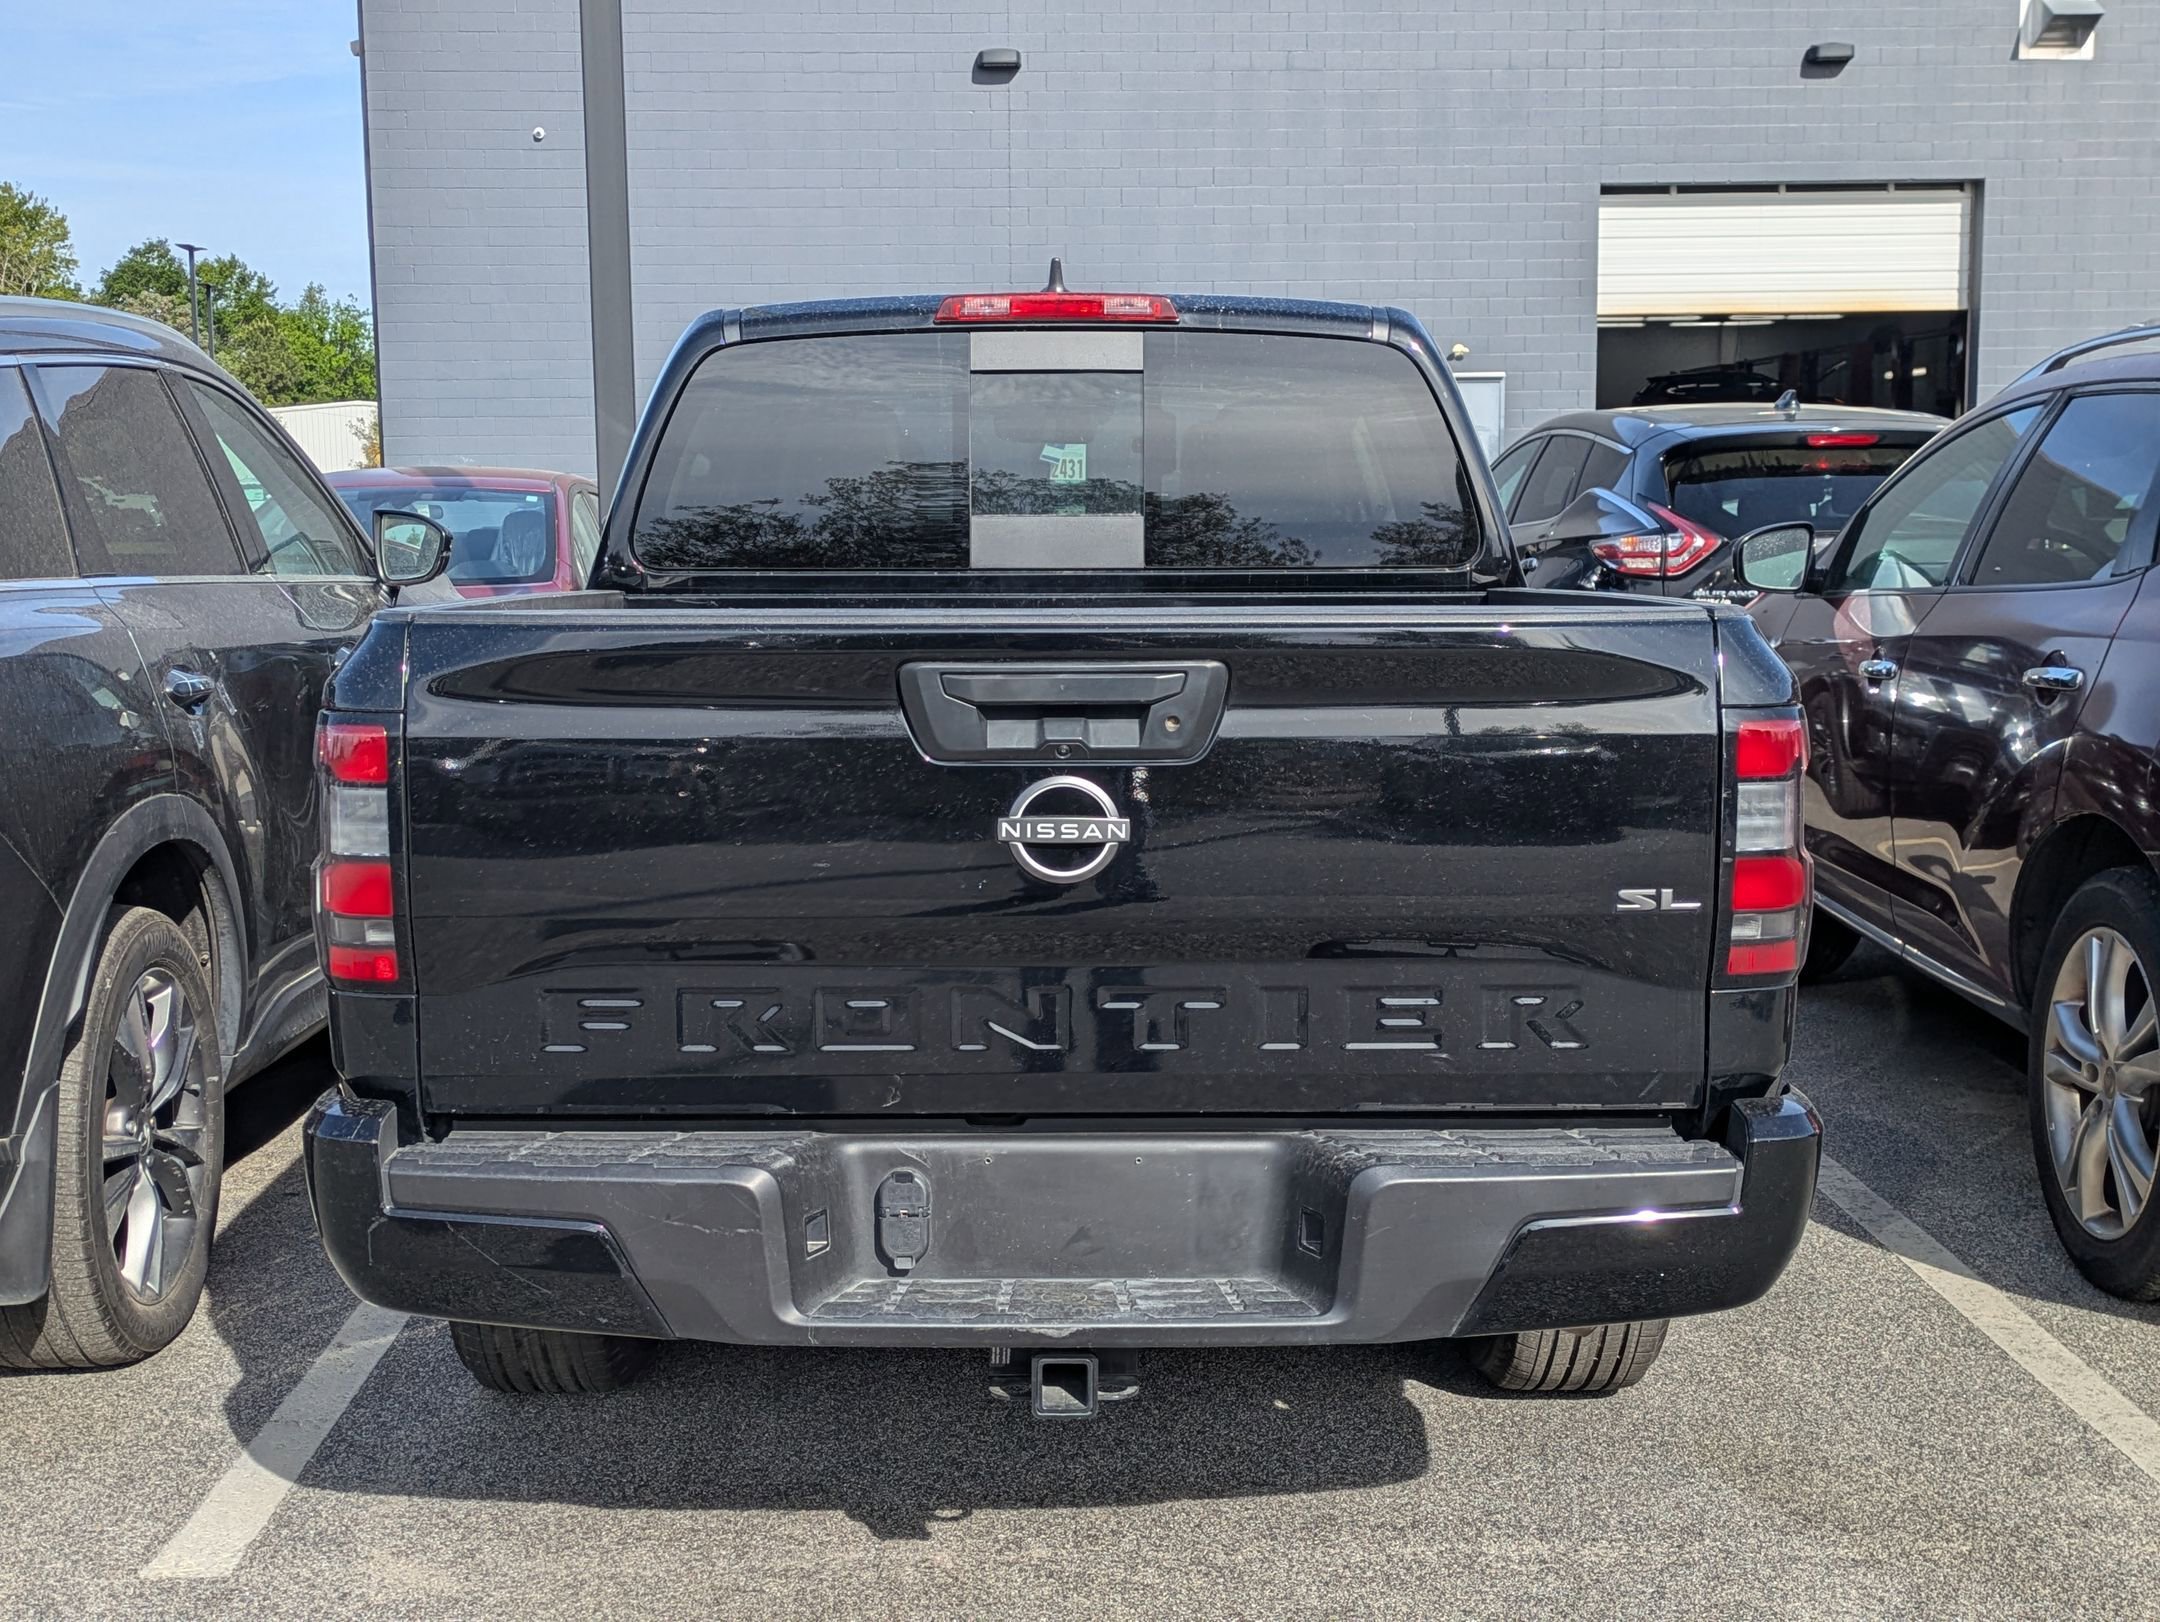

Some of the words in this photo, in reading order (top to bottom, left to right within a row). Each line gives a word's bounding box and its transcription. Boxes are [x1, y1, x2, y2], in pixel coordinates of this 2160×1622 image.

[1693, 590, 1759, 598] MURANO
[1001, 822, 1126, 839] NISSAN
[1616, 888, 1702, 911] SL
[540, 985, 1587, 1051] FRONTIER
